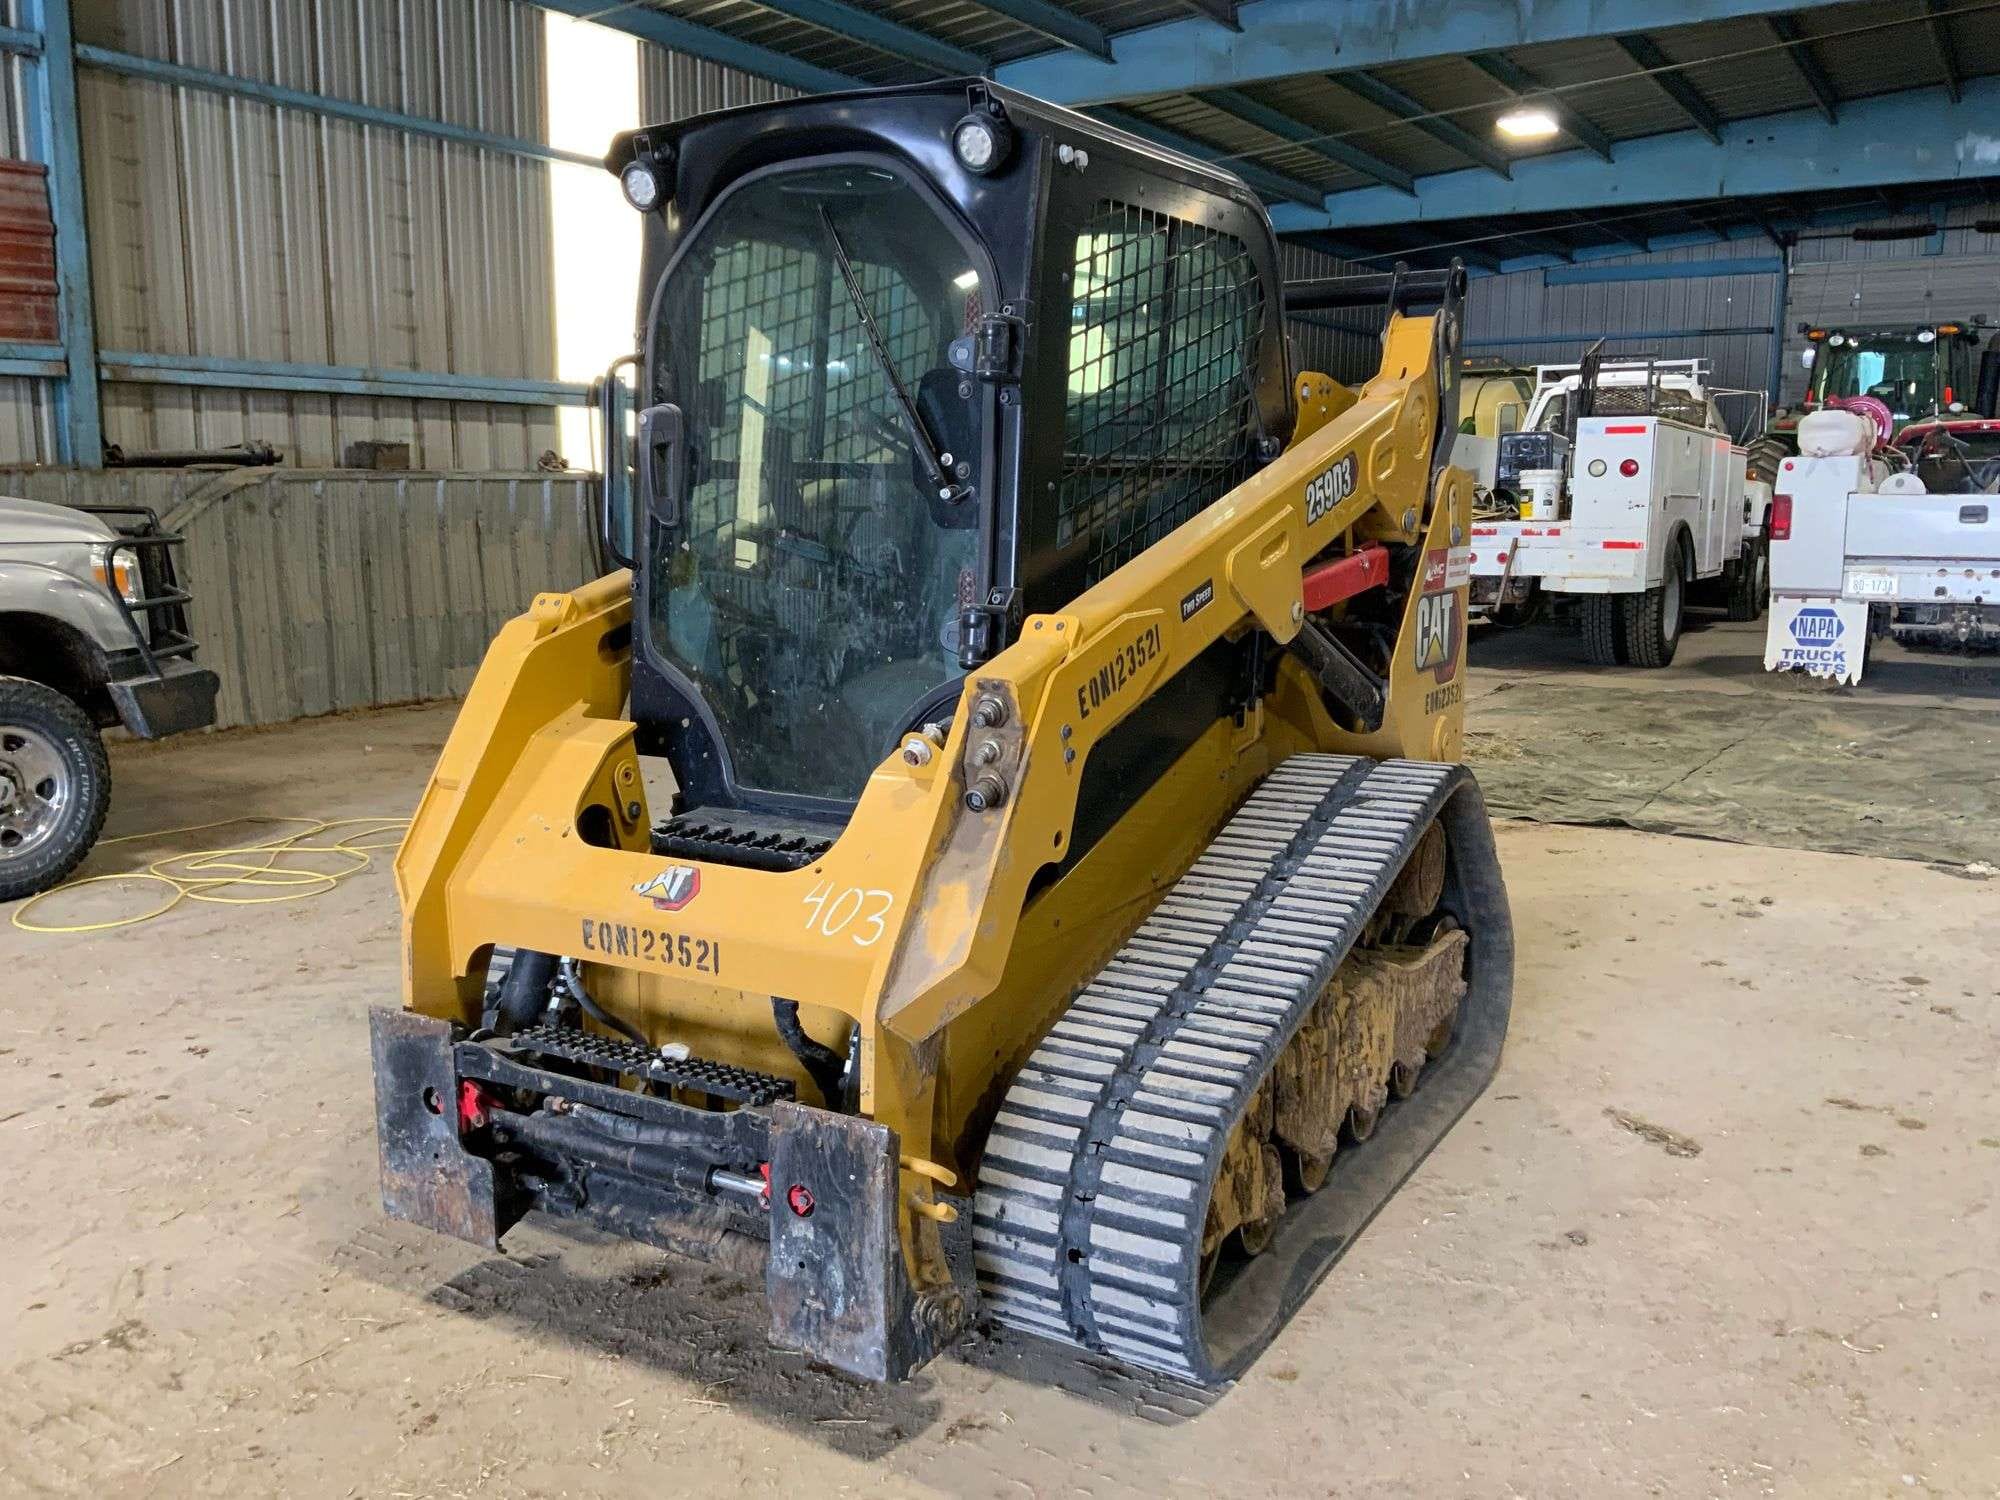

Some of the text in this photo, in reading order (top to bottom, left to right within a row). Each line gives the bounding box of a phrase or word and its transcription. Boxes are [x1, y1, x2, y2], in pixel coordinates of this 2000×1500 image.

[1306, 457, 1352, 526] 259D3
[1416, 592, 1454, 671] CAT
[1781, 648, 1846, 662] TRUCK
[1798, 617, 1835, 639] NAPA
[802, 880, 894, 946] 403
